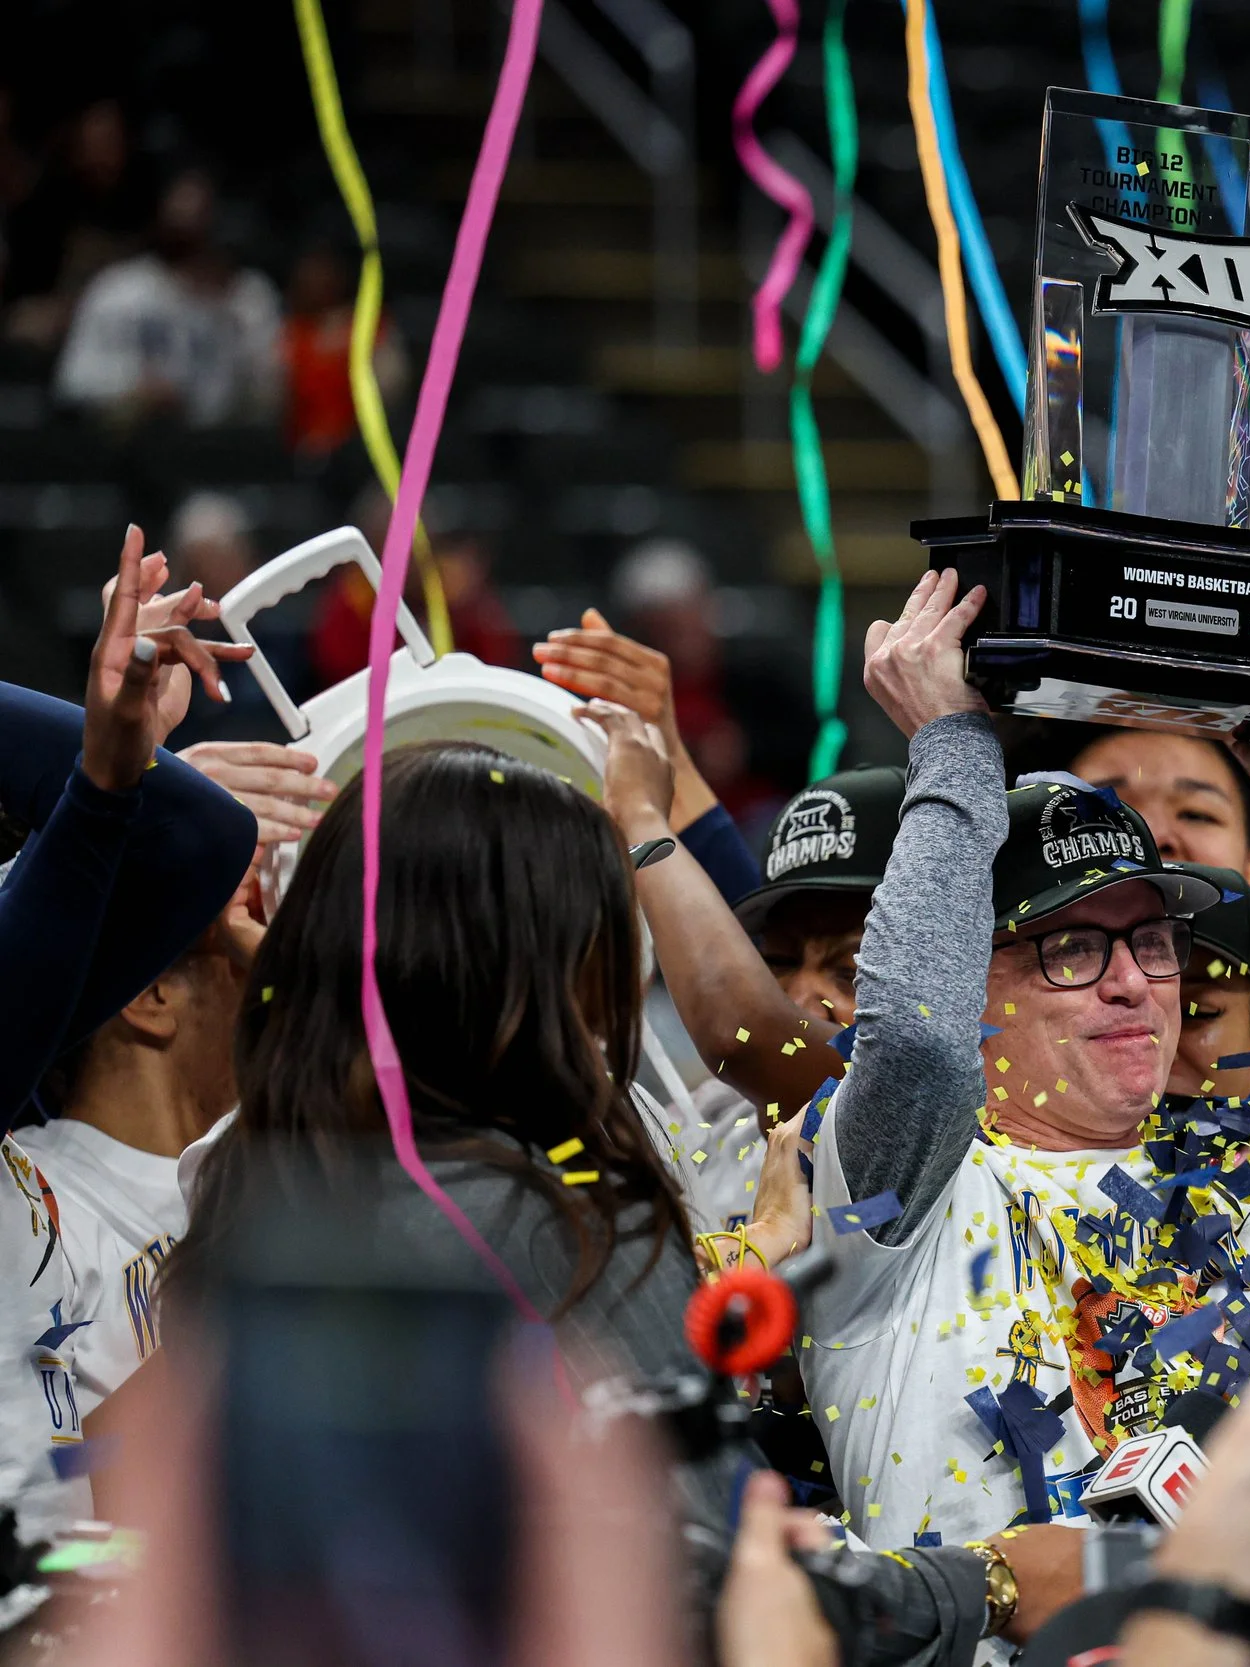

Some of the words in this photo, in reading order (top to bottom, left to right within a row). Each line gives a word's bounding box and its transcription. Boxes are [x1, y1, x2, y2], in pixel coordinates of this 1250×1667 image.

[1116, 146, 1153, 167] BIG
[1160, 152, 1184, 172] 12
[1080, 168, 1217, 202] TOURNAMENT
[1123, 566, 1185, 588] WOMEN'S
[1109, 595, 1137, 620] 20
[1148, 607, 1167, 619] WEST
[1168, 609, 1197, 622] VIRGINIA
[1198, 612, 1237, 627] UNIVERSITY
[1042, 831, 1146, 868] CHAMPS
